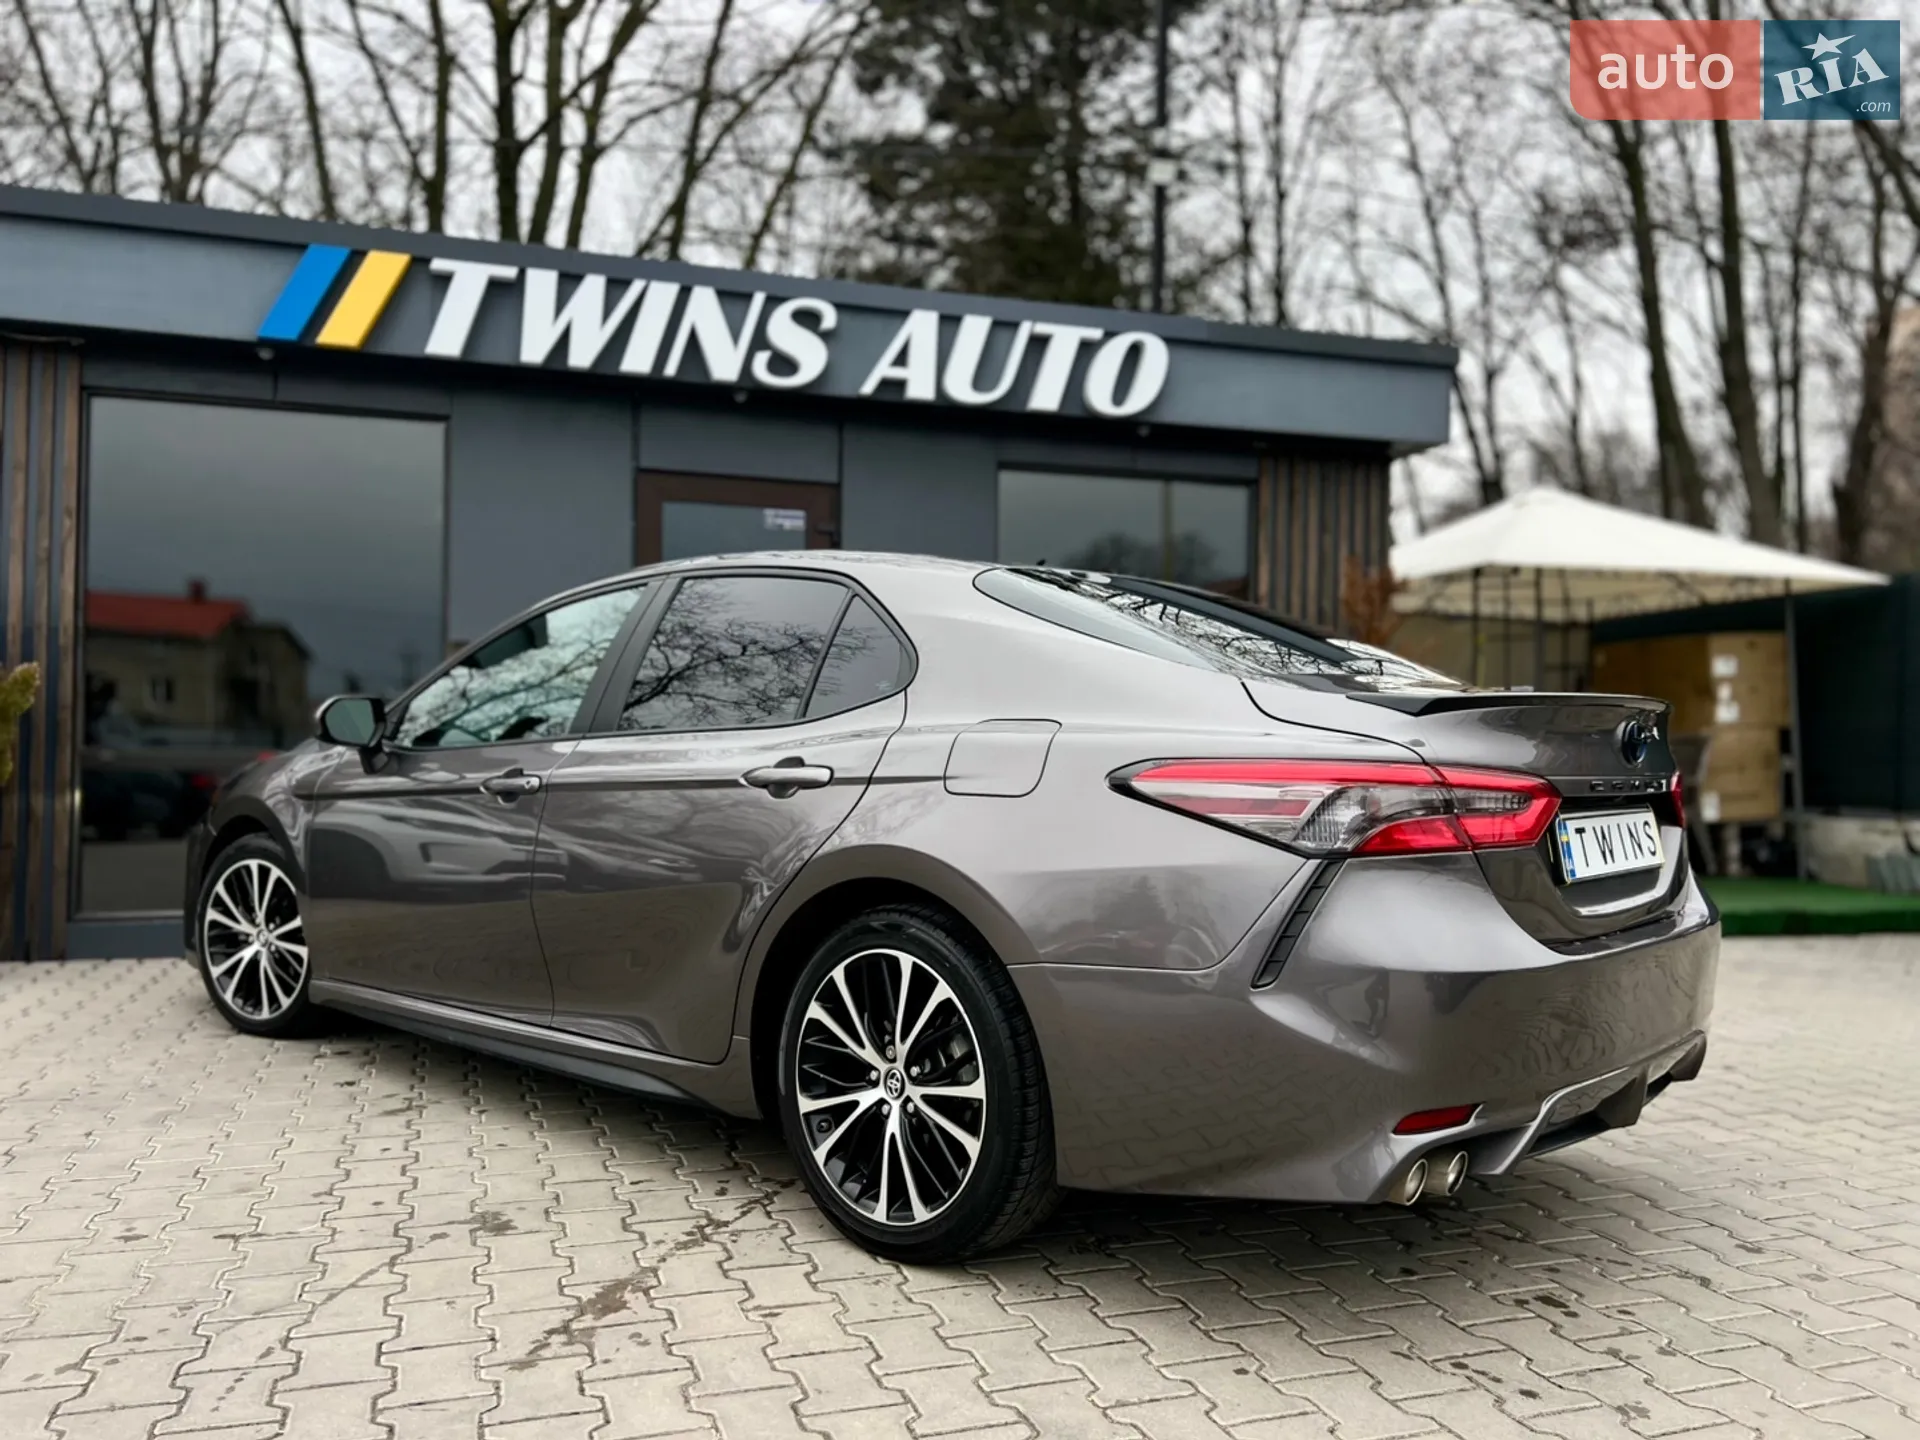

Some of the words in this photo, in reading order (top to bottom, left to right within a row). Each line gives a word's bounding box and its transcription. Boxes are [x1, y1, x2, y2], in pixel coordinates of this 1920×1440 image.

[424, 257, 839, 388] TWINS
[858, 308, 1169, 417] AUTO
[1574, 819, 1658, 868] TWINS
